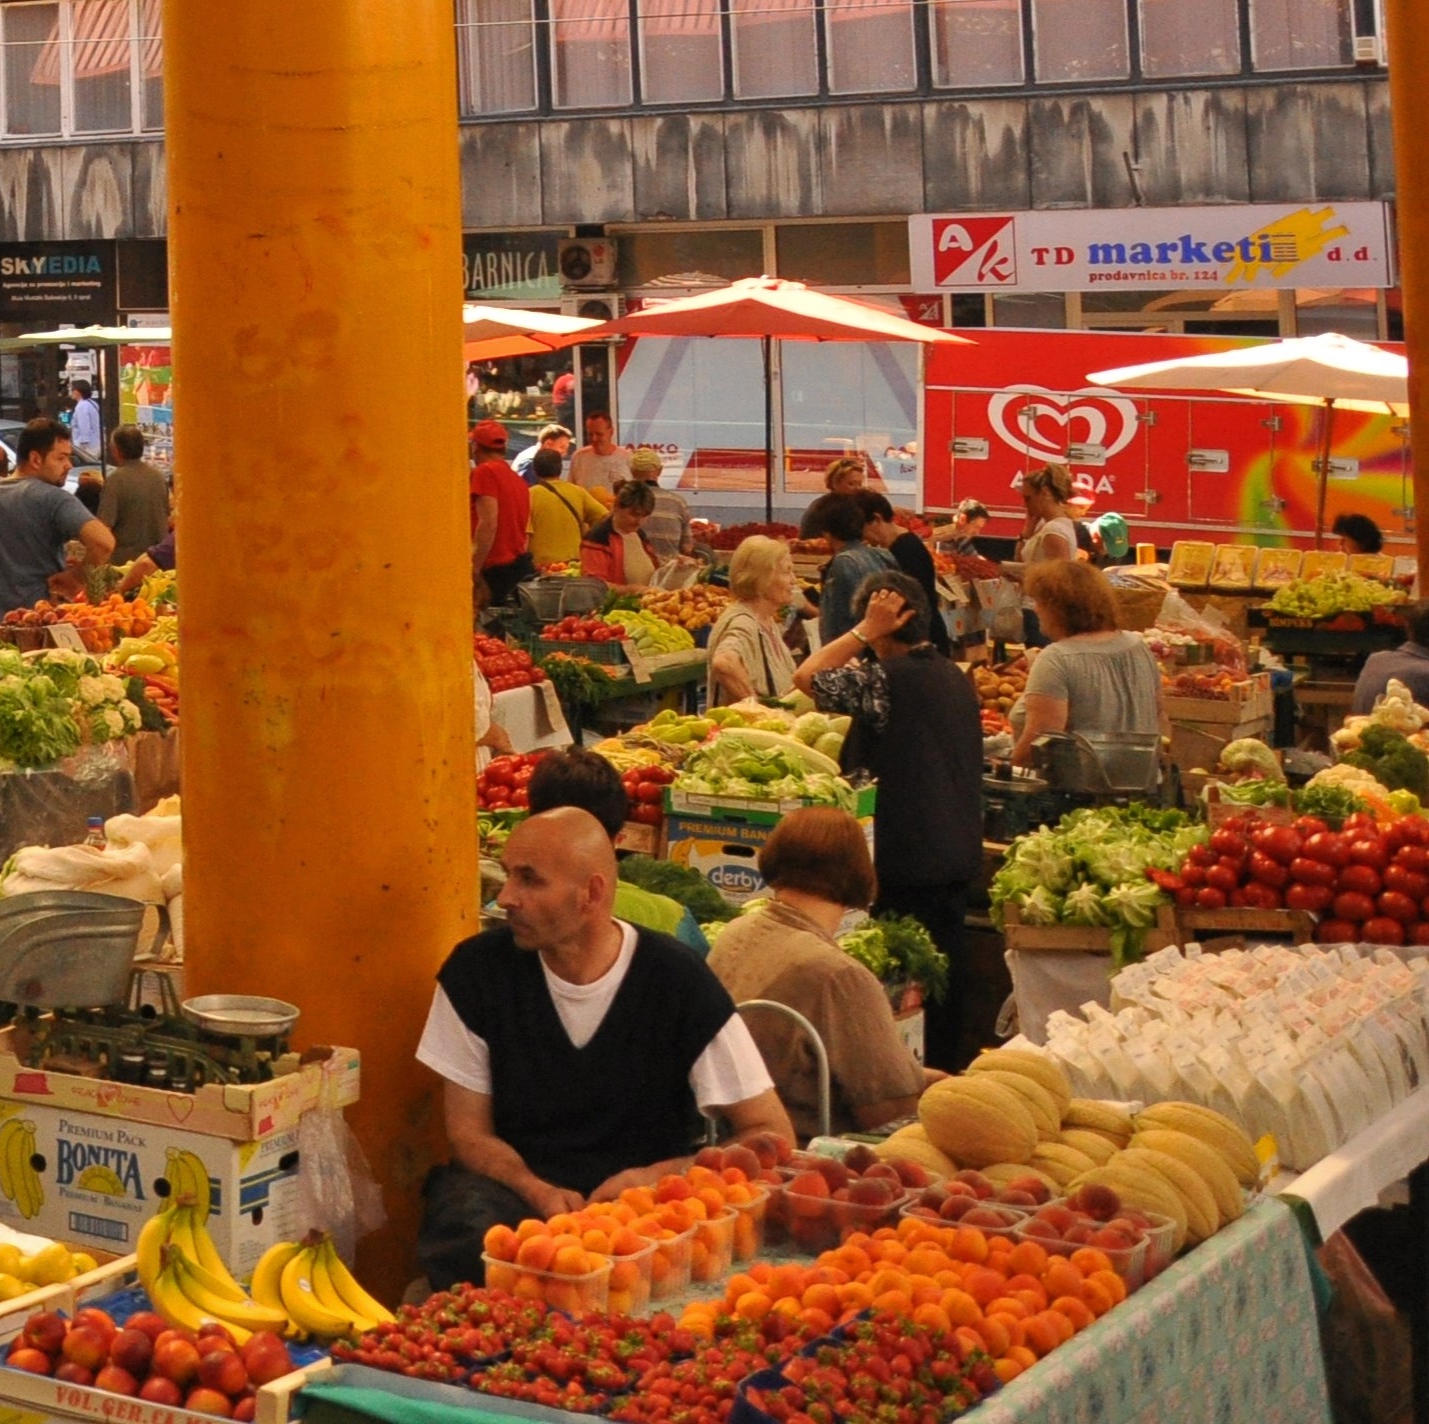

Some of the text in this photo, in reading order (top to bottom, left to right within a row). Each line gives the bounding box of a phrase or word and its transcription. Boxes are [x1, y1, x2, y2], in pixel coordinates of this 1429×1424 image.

[1089, 269, 1218, 283] prodavnica br. 124
[679, 821, 773, 841] PREMIUM BANA
[712, 865, 763, 893] derby
[58, 1119, 147, 1148] PREMIUM PACK
[56, 1139, 146, 1200] BONITA
